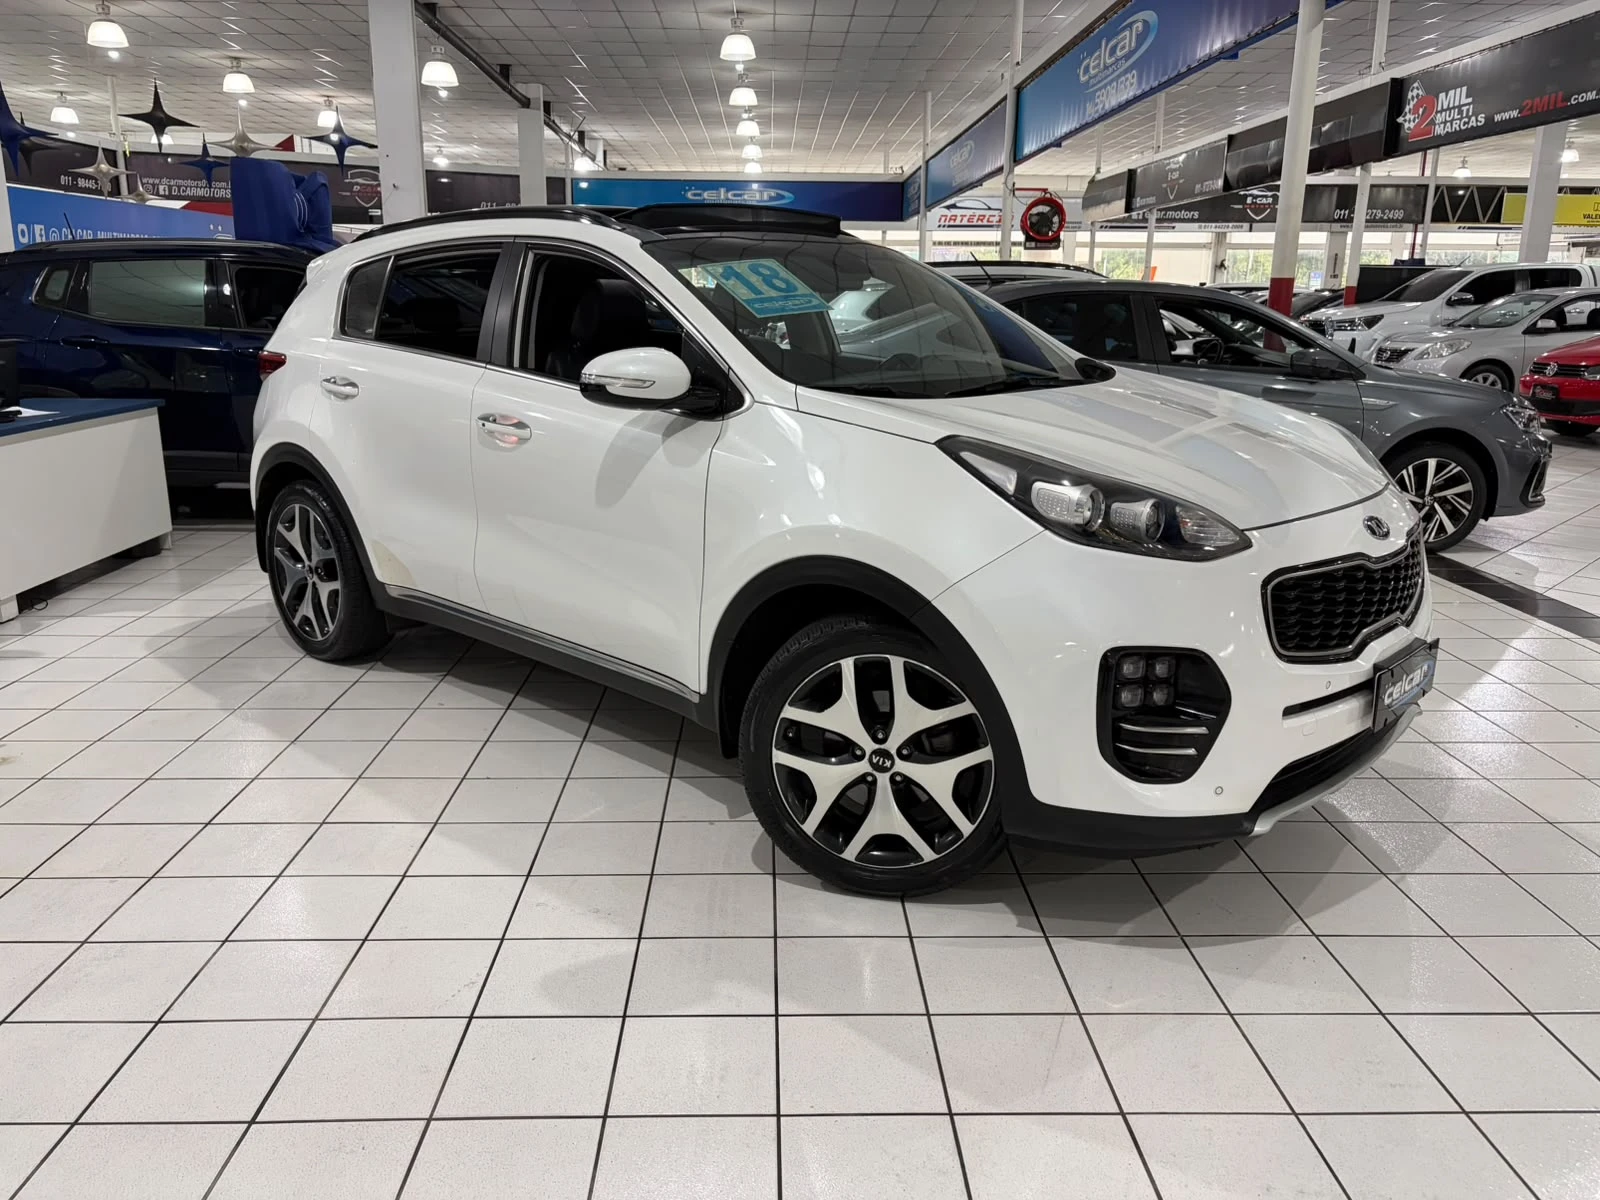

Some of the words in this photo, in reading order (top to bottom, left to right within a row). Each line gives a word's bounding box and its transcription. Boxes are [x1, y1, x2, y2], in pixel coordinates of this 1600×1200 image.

[1080, 20, 1143, 83] celcar
[1408, 96, 1438, 142] 2
[1437, 86, 1473, 112] MIL
[1434, 105, 1473, 124] MULTI
[1494, 90, 1600, 123] www.2MIL.COM.
[1434, 114, 1486, 136] MARCAS
[60, 175, 72, 186] 011
[687, 187, 777, 200] celcar
[1334, 208, 1349, 220] 011
[720, 263, 799, 297] 18
[1385, 665, 1426, 703] celcar
[872, 754, 892, 768] KIA
